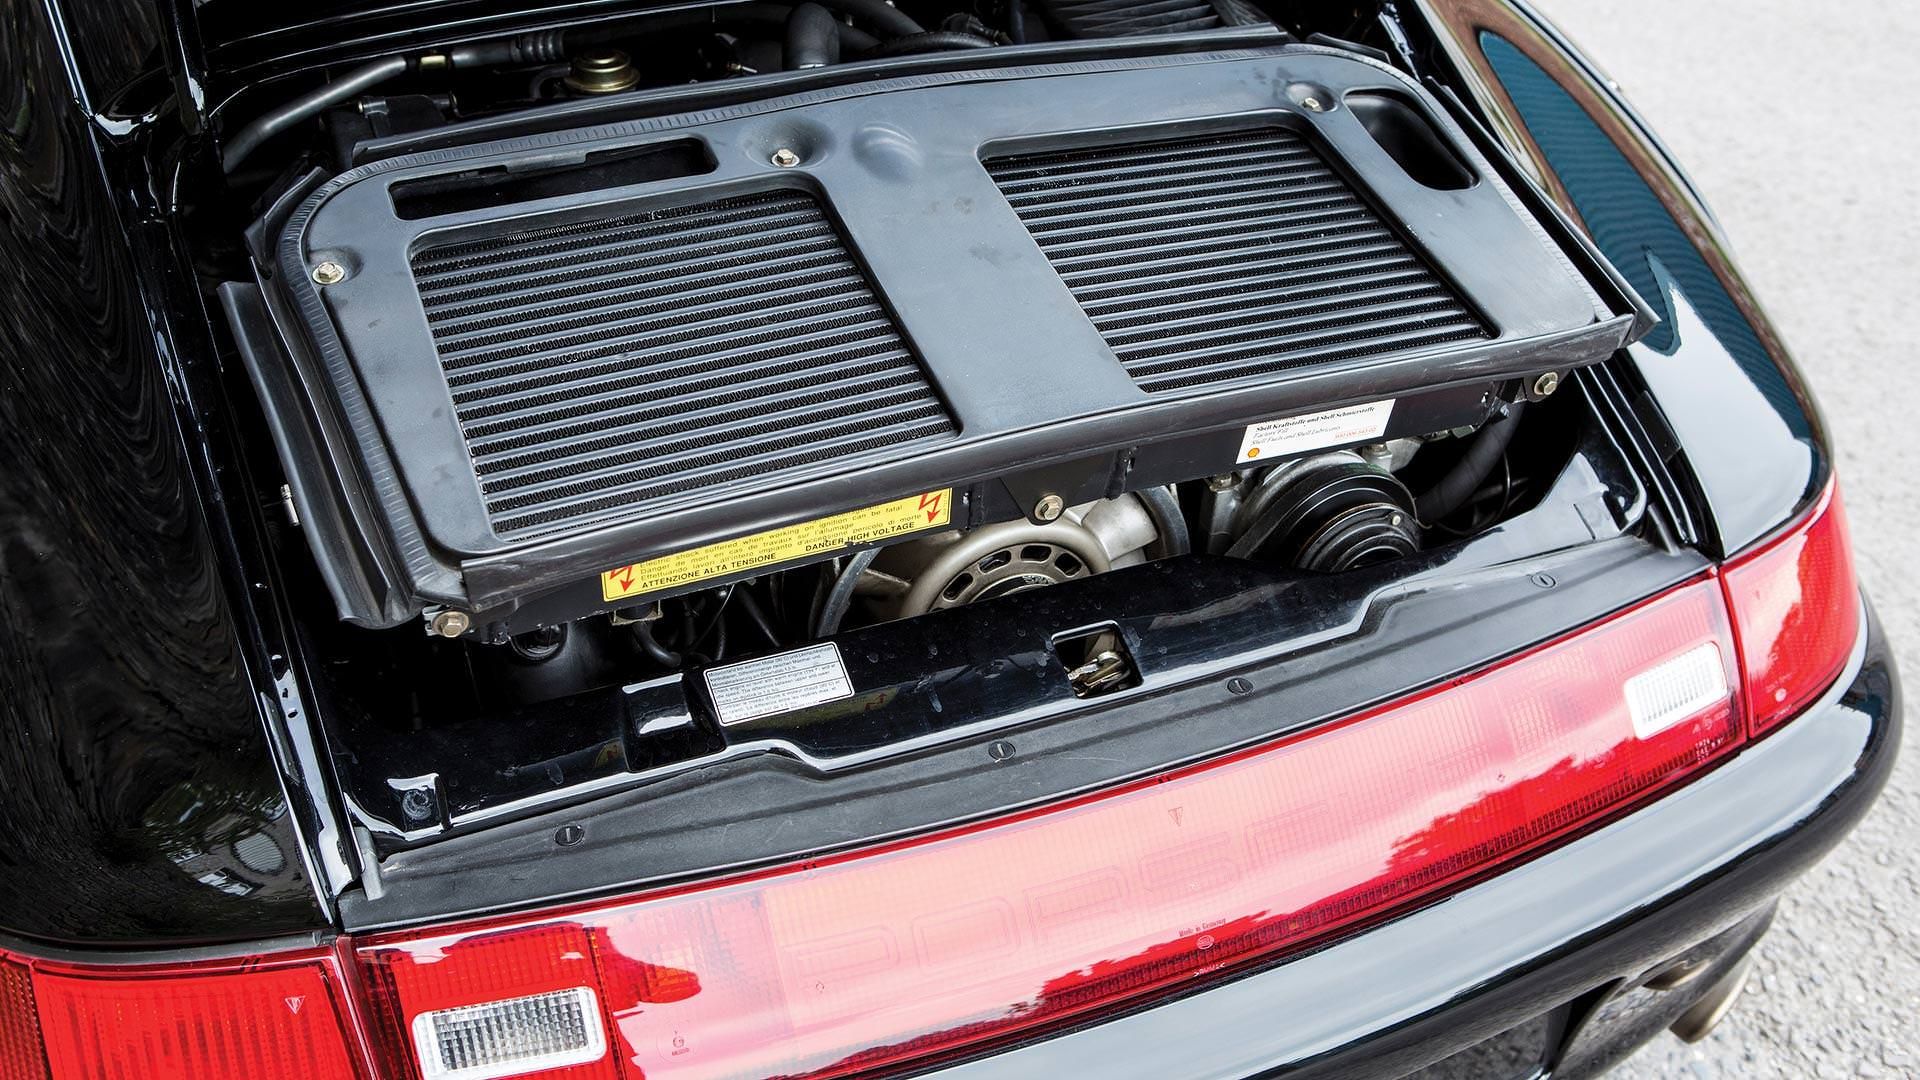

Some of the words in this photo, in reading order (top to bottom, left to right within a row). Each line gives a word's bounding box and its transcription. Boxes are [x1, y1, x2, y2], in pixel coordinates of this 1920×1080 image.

[704, 541, 737, 553] suffered
[742, 536, 763, 545] when
[769, 528, 799, 539] working
[805, 537, 843, 551] DANGER
[847, 531, 869, 541] HIGH
[872, 521, 914, 536] VOLTAGE
[640, 563, 670, 575] Danger
[641, 569, 699, 588] ATTENZIONE
[703, 563, 727, 574] ALTA
[731, 552, 776, 568] TENSIONE
